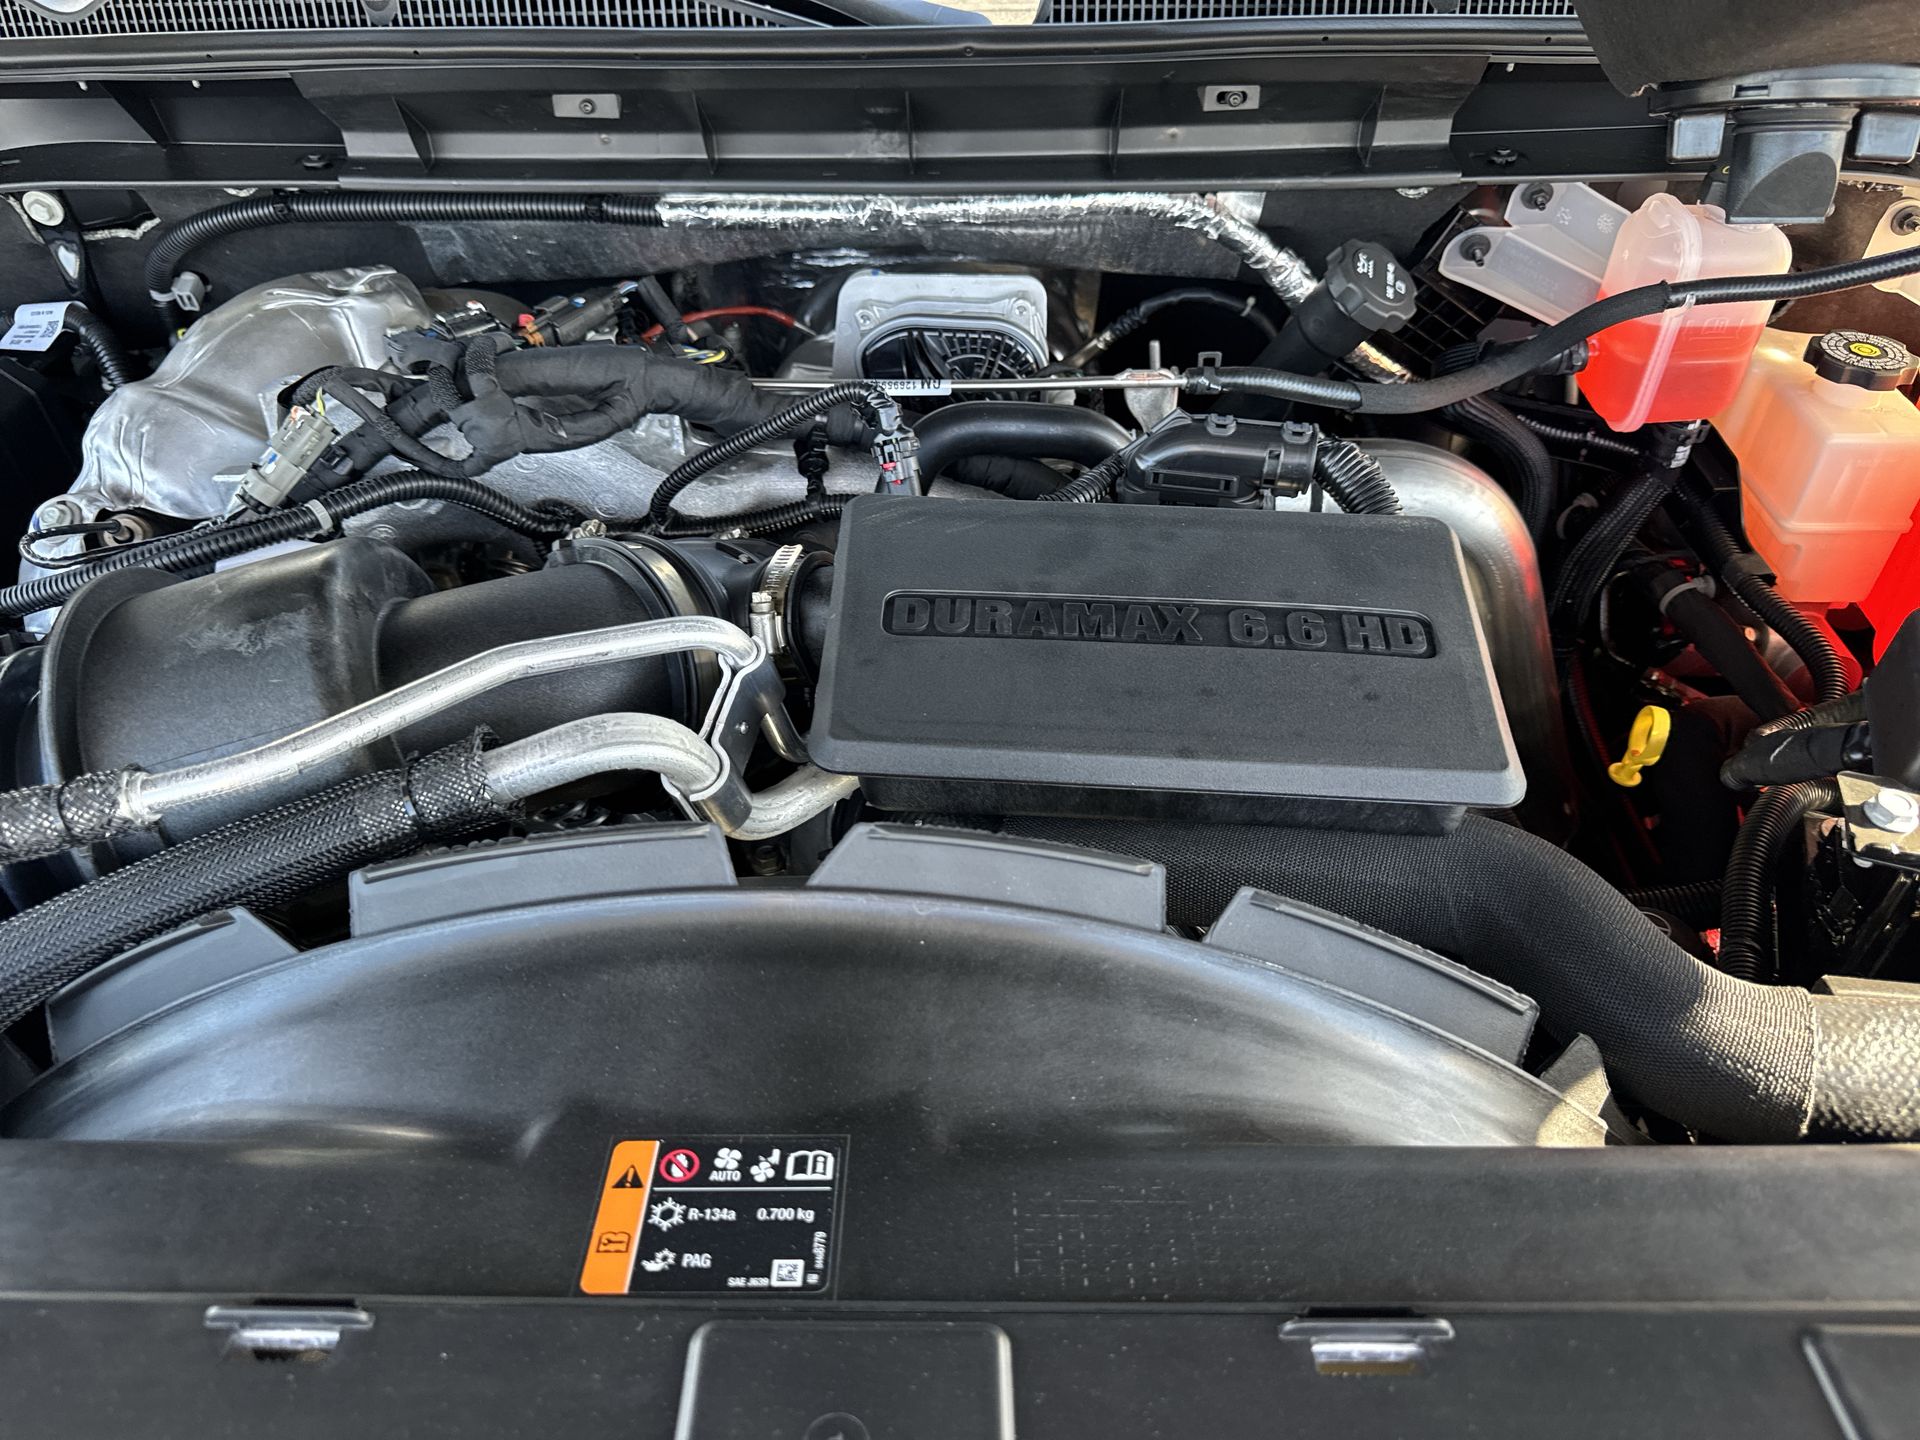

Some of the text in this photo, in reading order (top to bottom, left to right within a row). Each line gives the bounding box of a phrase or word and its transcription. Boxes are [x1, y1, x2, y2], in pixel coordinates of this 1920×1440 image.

[920, 379, 941, 390] GM
[891, 597, 1428, 654] DURAMAX 6.6 HD
[709, 1170, 741, 1182] AUTO
[687, 1207, 815, 1224] R-134a 0.700 kg
[682, 1253, 713, 1269] PAG
[727, 1276, 746, 1288] SAE
